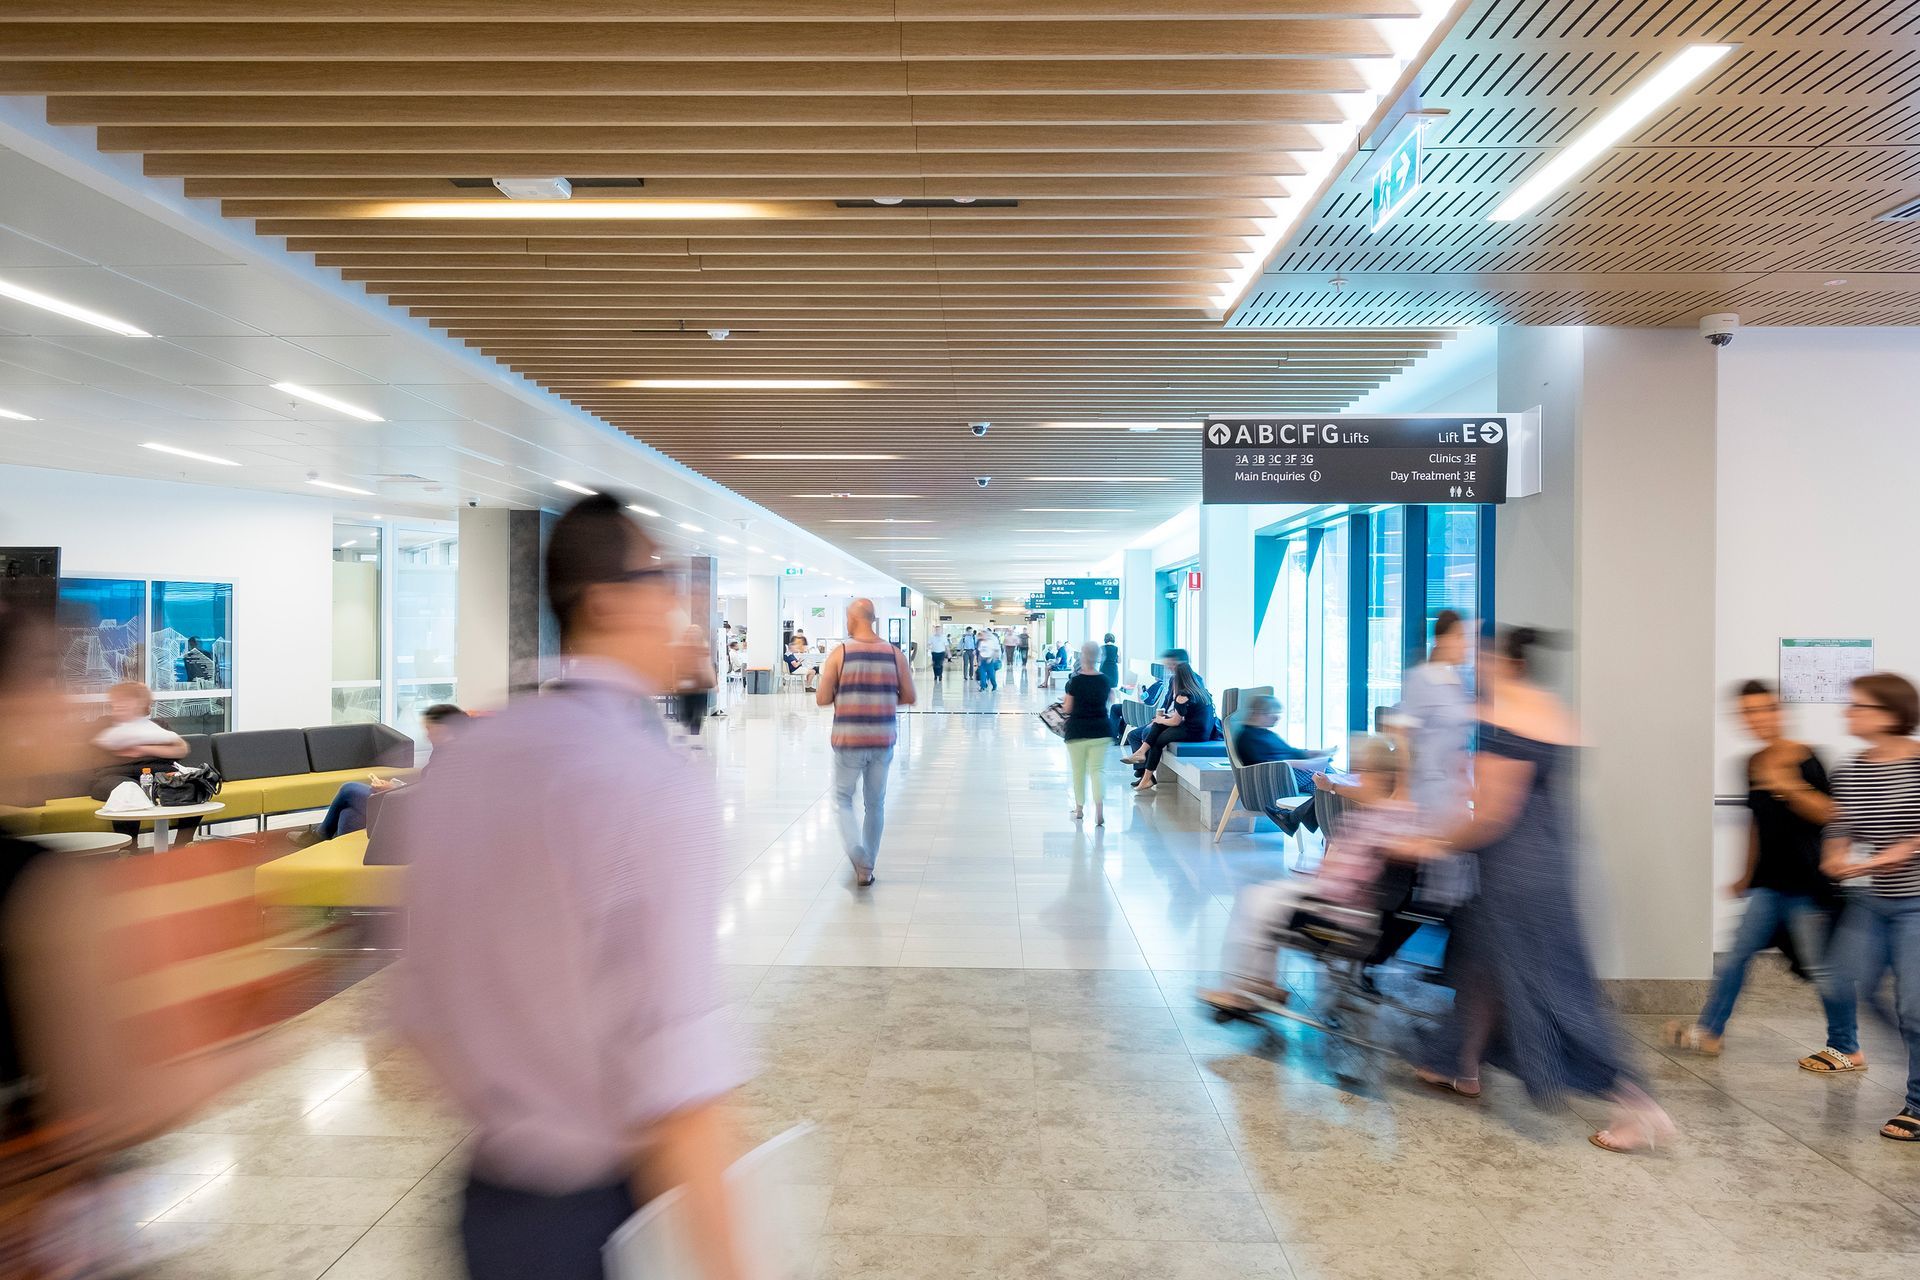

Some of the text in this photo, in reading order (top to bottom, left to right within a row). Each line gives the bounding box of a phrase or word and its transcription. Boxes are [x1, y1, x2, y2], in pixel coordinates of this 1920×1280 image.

[1342, 433, 1369, 444] Lifts
[1438, 423, 1477, 443] Lift E
[1235, 455, 1314, 465] 3A 3B 3C 3F 3G
[1429, 453, 1477, 464] Clinics 3E
[1234, 471, 1305, 483] Main Enquiries
[1390, 470, 1476, 483] Day Treatment 3E
